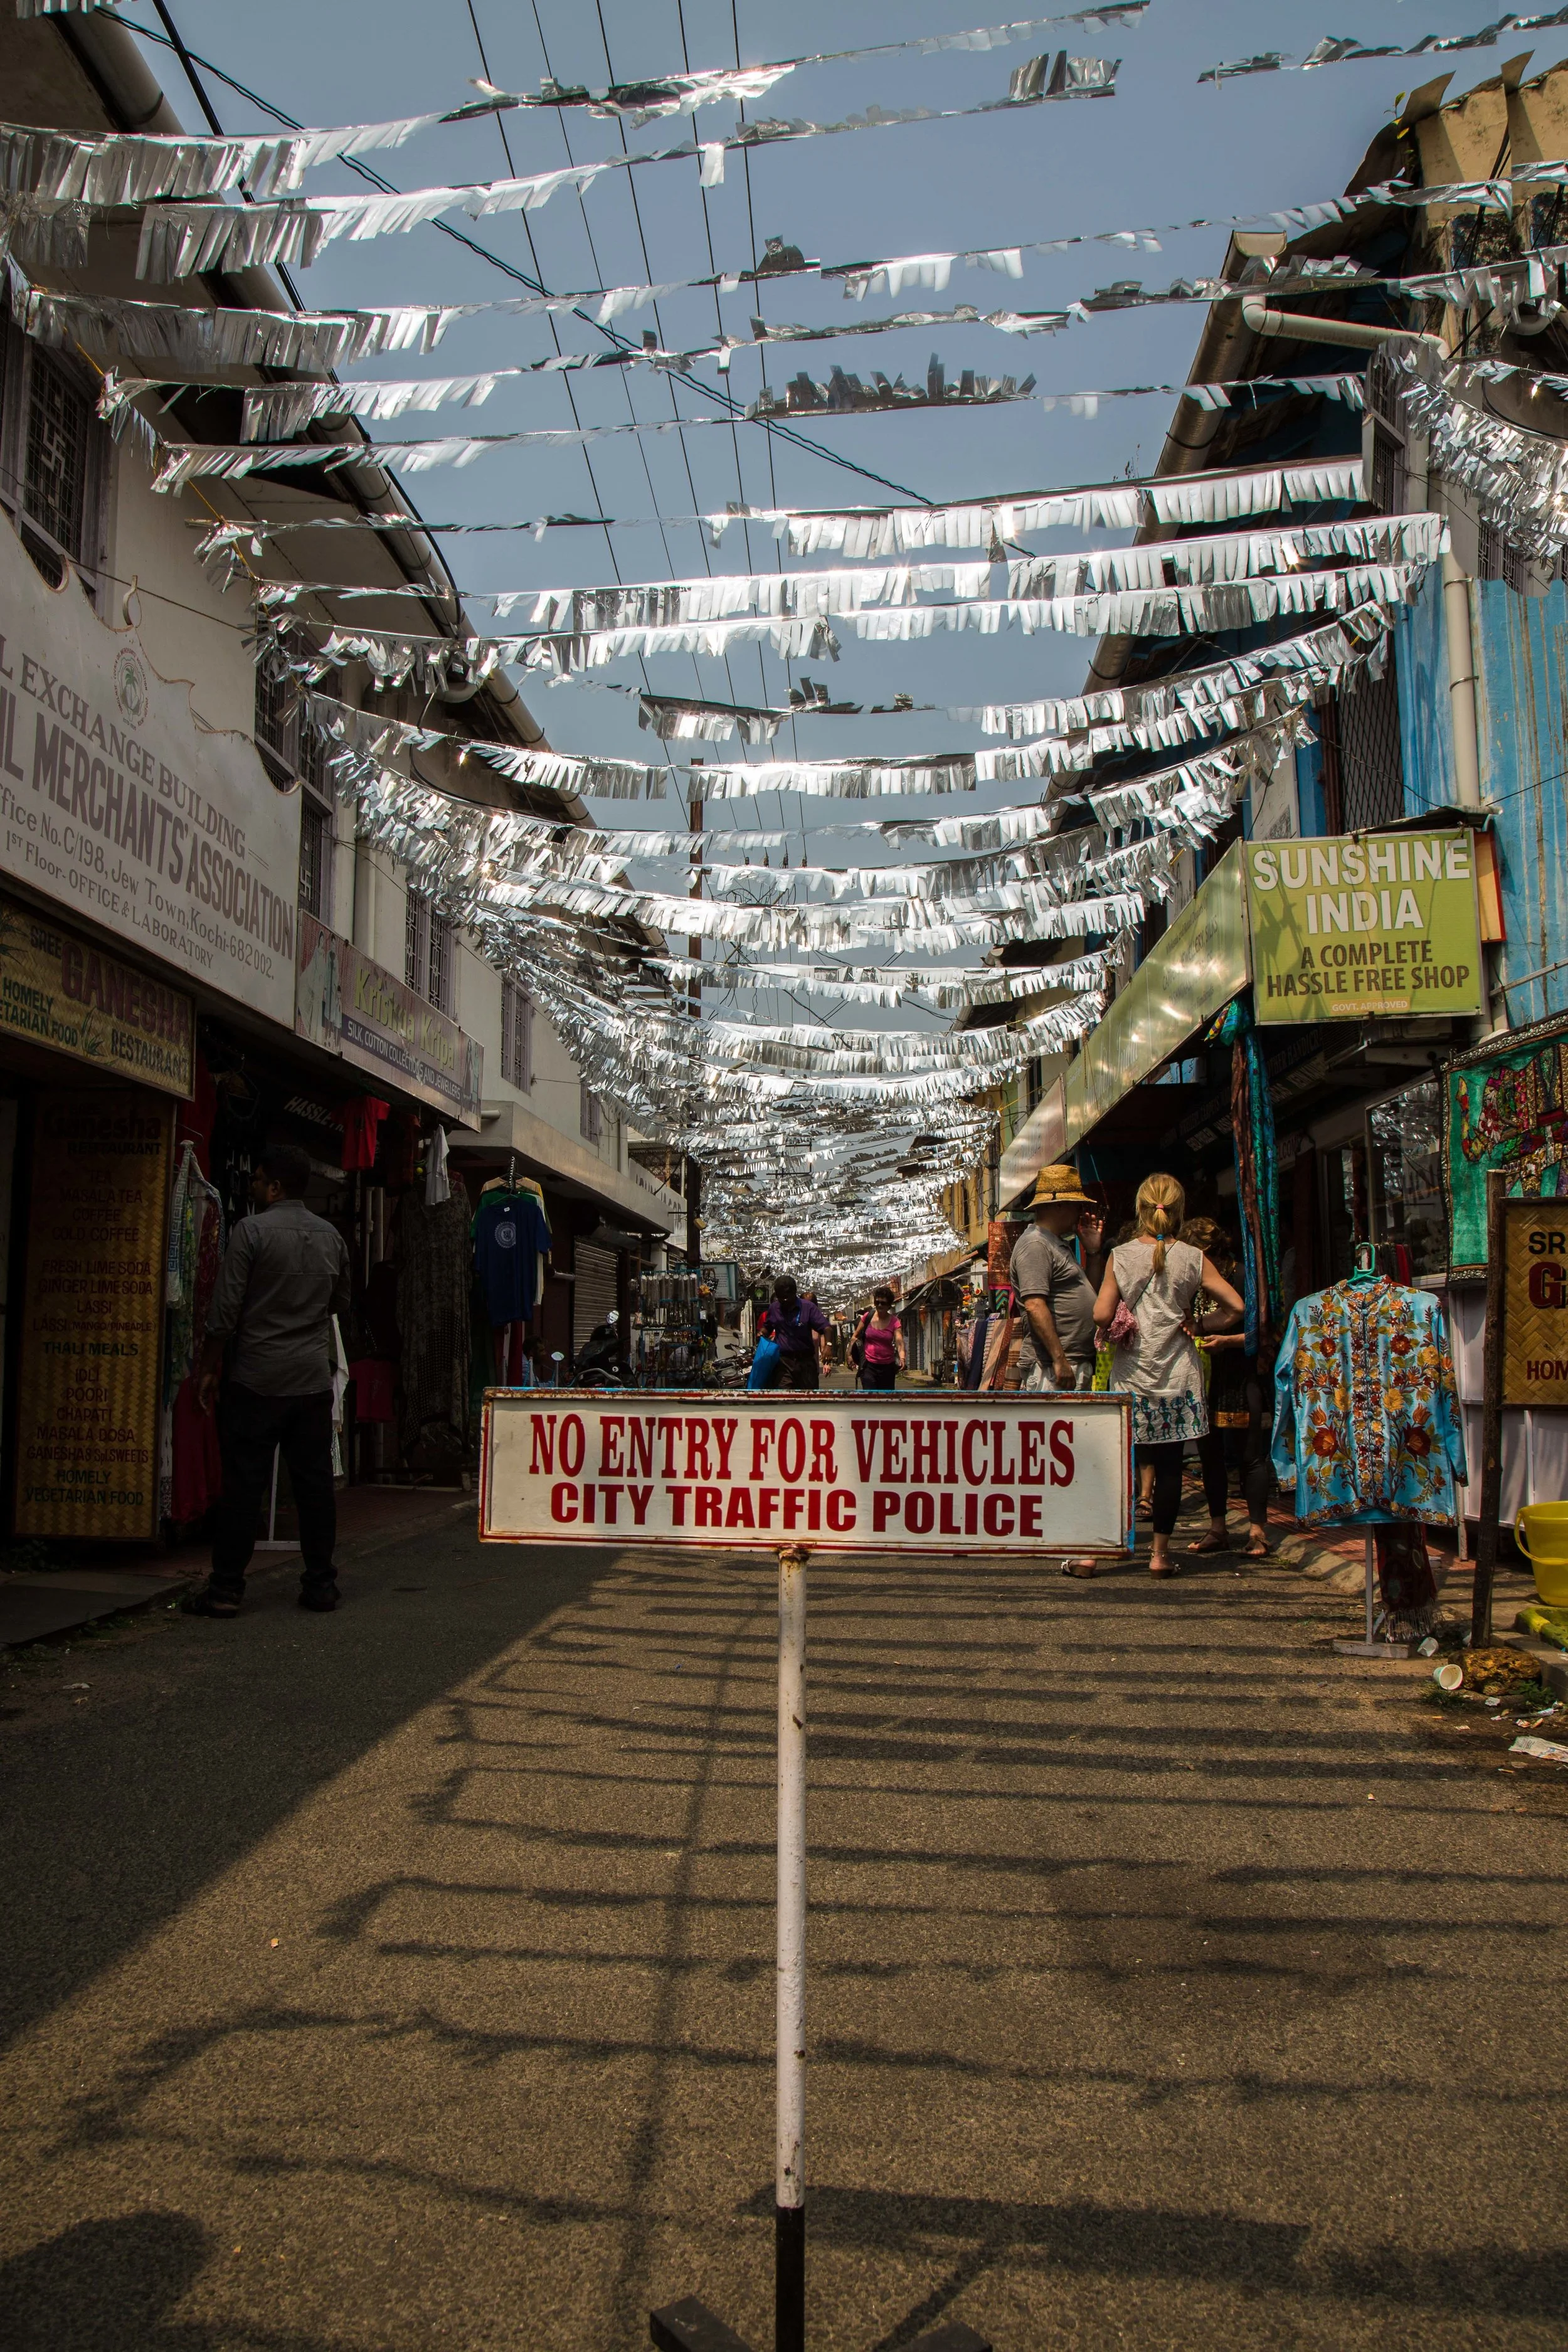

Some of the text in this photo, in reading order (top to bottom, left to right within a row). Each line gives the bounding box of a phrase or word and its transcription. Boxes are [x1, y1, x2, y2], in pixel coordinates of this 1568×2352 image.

[20, 653, 155, 787] EXCHANGE
[158, 762, 245, 860] BUILDING
[0, 783, 37, 832] fice
[40, 812, 61, 847] No.
[64, 826, 108, 880] C/198,
[112, 859, 139, 896] Jew
[32, 712, 188, 884] MERCHANTS'
[186, 832, 293, 961] ASSOCIATION
[1254, 839, 1470, 890] SUNSHINE
[6, 830, 23, 851] 1ST
[69, 869, 120, 913] OFFICE
[122, 901, 129, 918] &
[132, 906, 213, 968] LABORATORY
[1306, 888, 1424, 934] INDIA
[1301, 940, 1433, 968] A COMPLETE
[31, 925, 189, 1046] SREE GANESHA
[1268, 965, 1470, 997] HASSLE FREE SHOP
[3, 977, 54, 1014] HOMELY
[1332, 1000, 1407, 1012] GOVT. APPROVED
[355, 967, 454, 1071] Krishna Kripa
[51, 1022, 78, 1047] FOOD
[111, 1029, 188, 1079] RESTAURANT
[347, 1020, 363, 1046] SILK,
[364, 1030, 388, 1058] COTTON
[423, 1068, 435, 1084] AND
[435, 1075, 461, 1099] JEWELLERS
[67, 1142, 161, 1155] RESTAURANT
[90, 1169, 112, 1184] TEA
[60, 1189, 142, 1204] MASALA TEA
[73, 1207, 121, 1222] COFFEE
[52, 1227, 139, 1242] COLD COFFEE
[41, 1259, 151, 1275] FRESH LIME SODA
[38, 1278, 152, 1295] GINGER LIME SODA
[1528, 1261, 1568, 1310] G
[76, 1300, 112, 1314] LASSI
[43, 1342, 139, 1356] THALI MEALS
[76, 1369, 99, 1382] IDLI
[66, 1387, 107, 1402] POORI
[56, 1407, 112, 1422] CHAPATI
[37, 1426, 135, 1443] MASALA DOSA
[529, 1414, 1074, 1486] NO ENTRY FOR VEHICLES
[56, 1470, 112, 1485] HOMELY
[26, 1488, 144, 1505] VEGETARIAN FOOD
[551, 1481, 1042, 1537] CITY TRAFFIC POLICE
